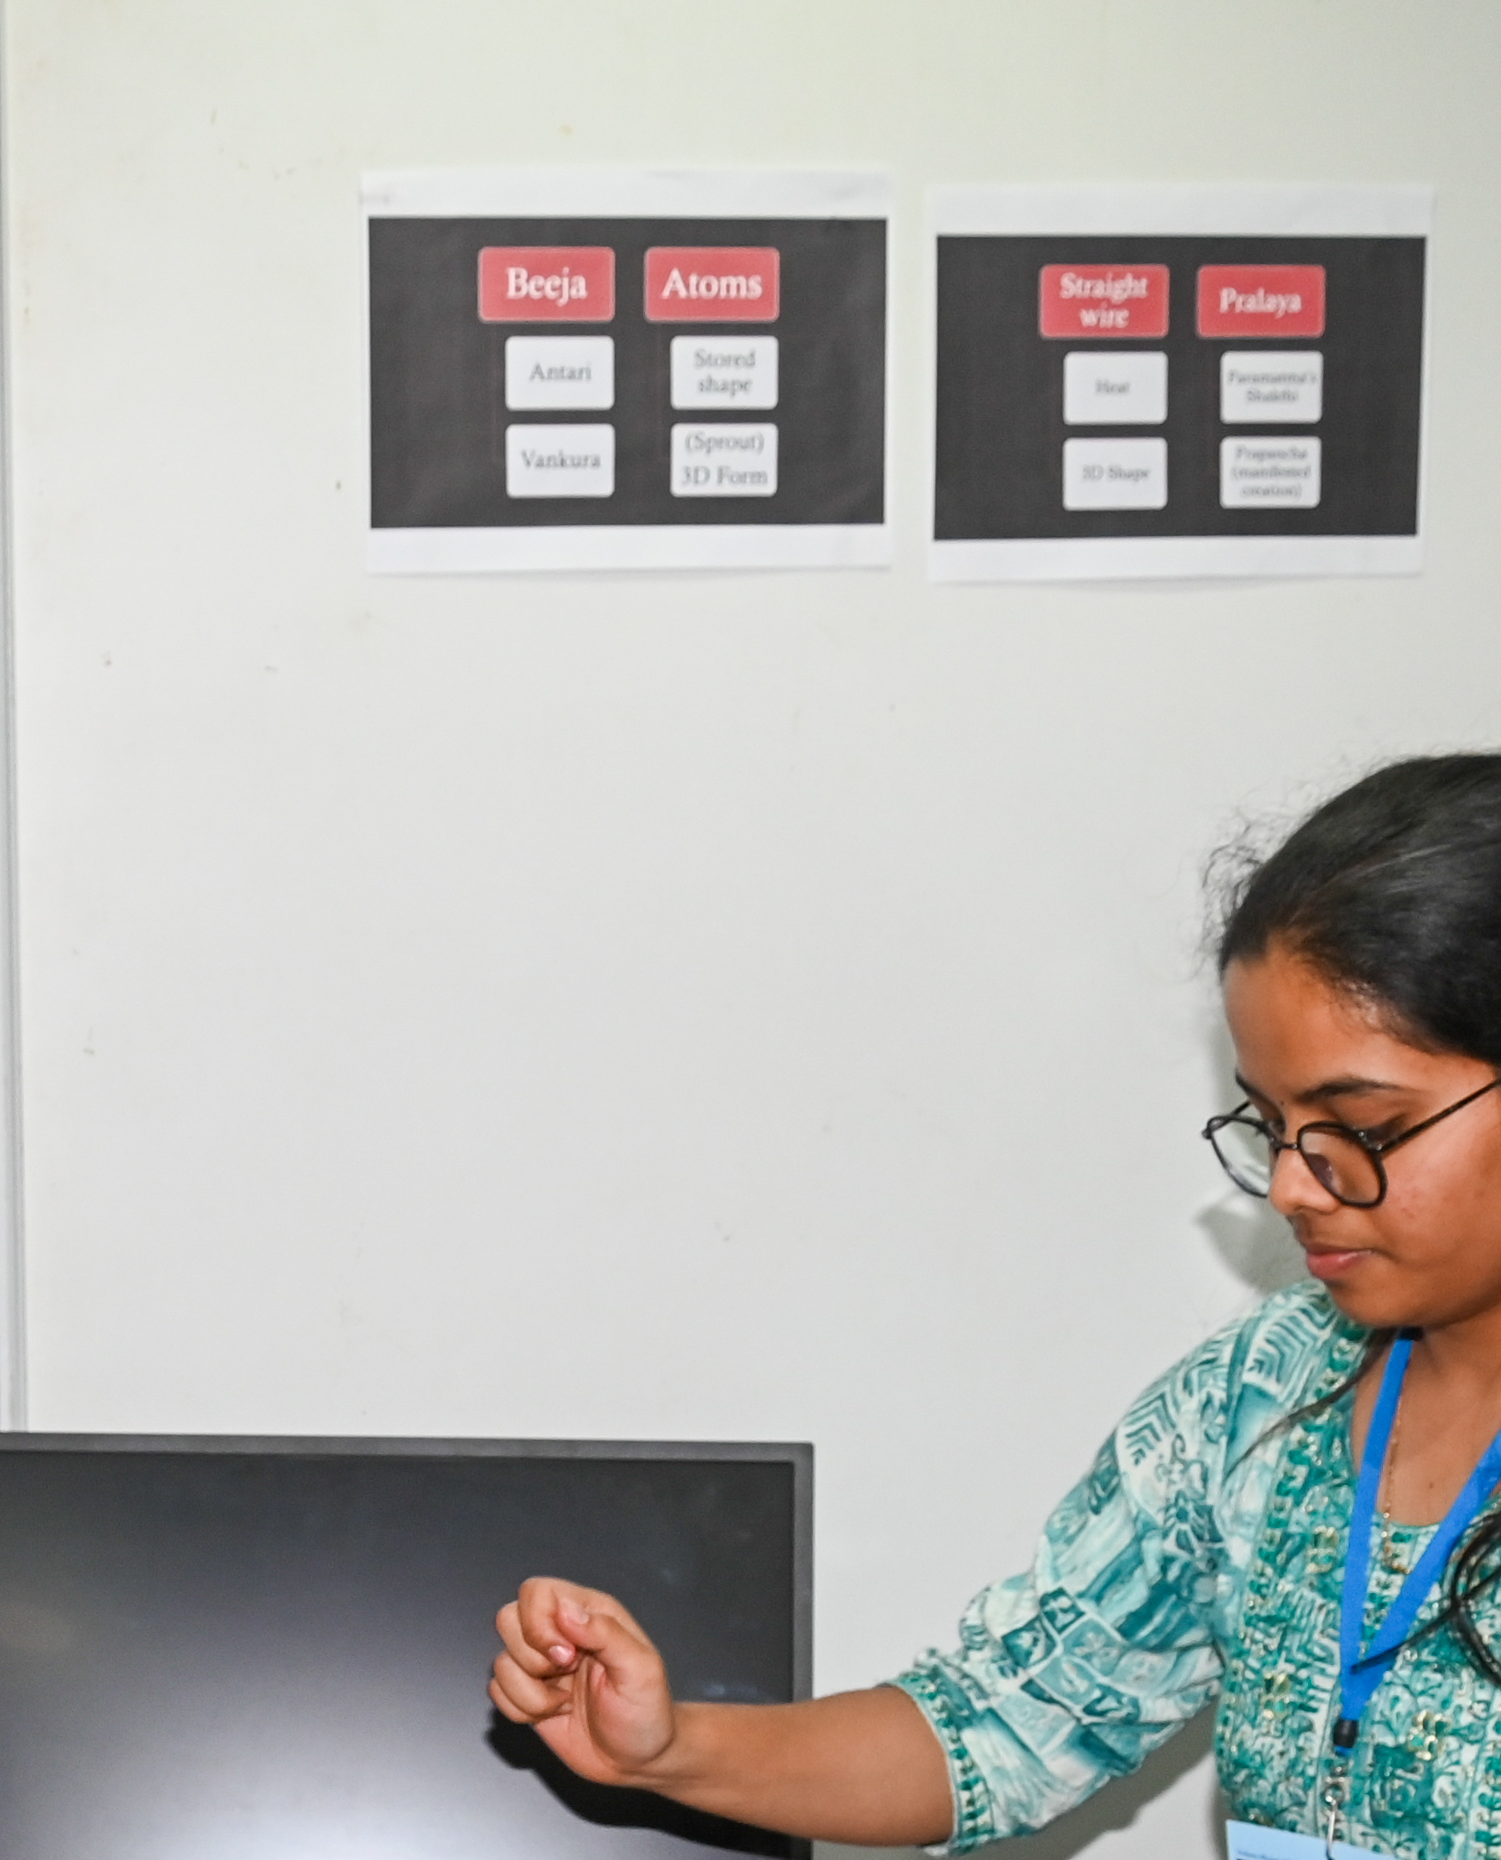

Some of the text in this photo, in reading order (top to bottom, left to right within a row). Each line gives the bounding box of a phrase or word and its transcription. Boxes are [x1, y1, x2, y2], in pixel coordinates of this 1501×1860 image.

[506, 268, 587, 307] Beeja
[661, 268, 763, 300] Atoms
[1060, 272, 1148, 304] Straight
[1219, 288, 1302, 319] Pralaya
[1080, 306, 1129, 329] wire
[694, 349, 756, 370] Stored
[698, 375, 753, 398] shape
[685, 431, 765, 455] (Sprout)
[520, 450, 601, 471] Vankura
[681, 465, 768, 486] 3D Form
